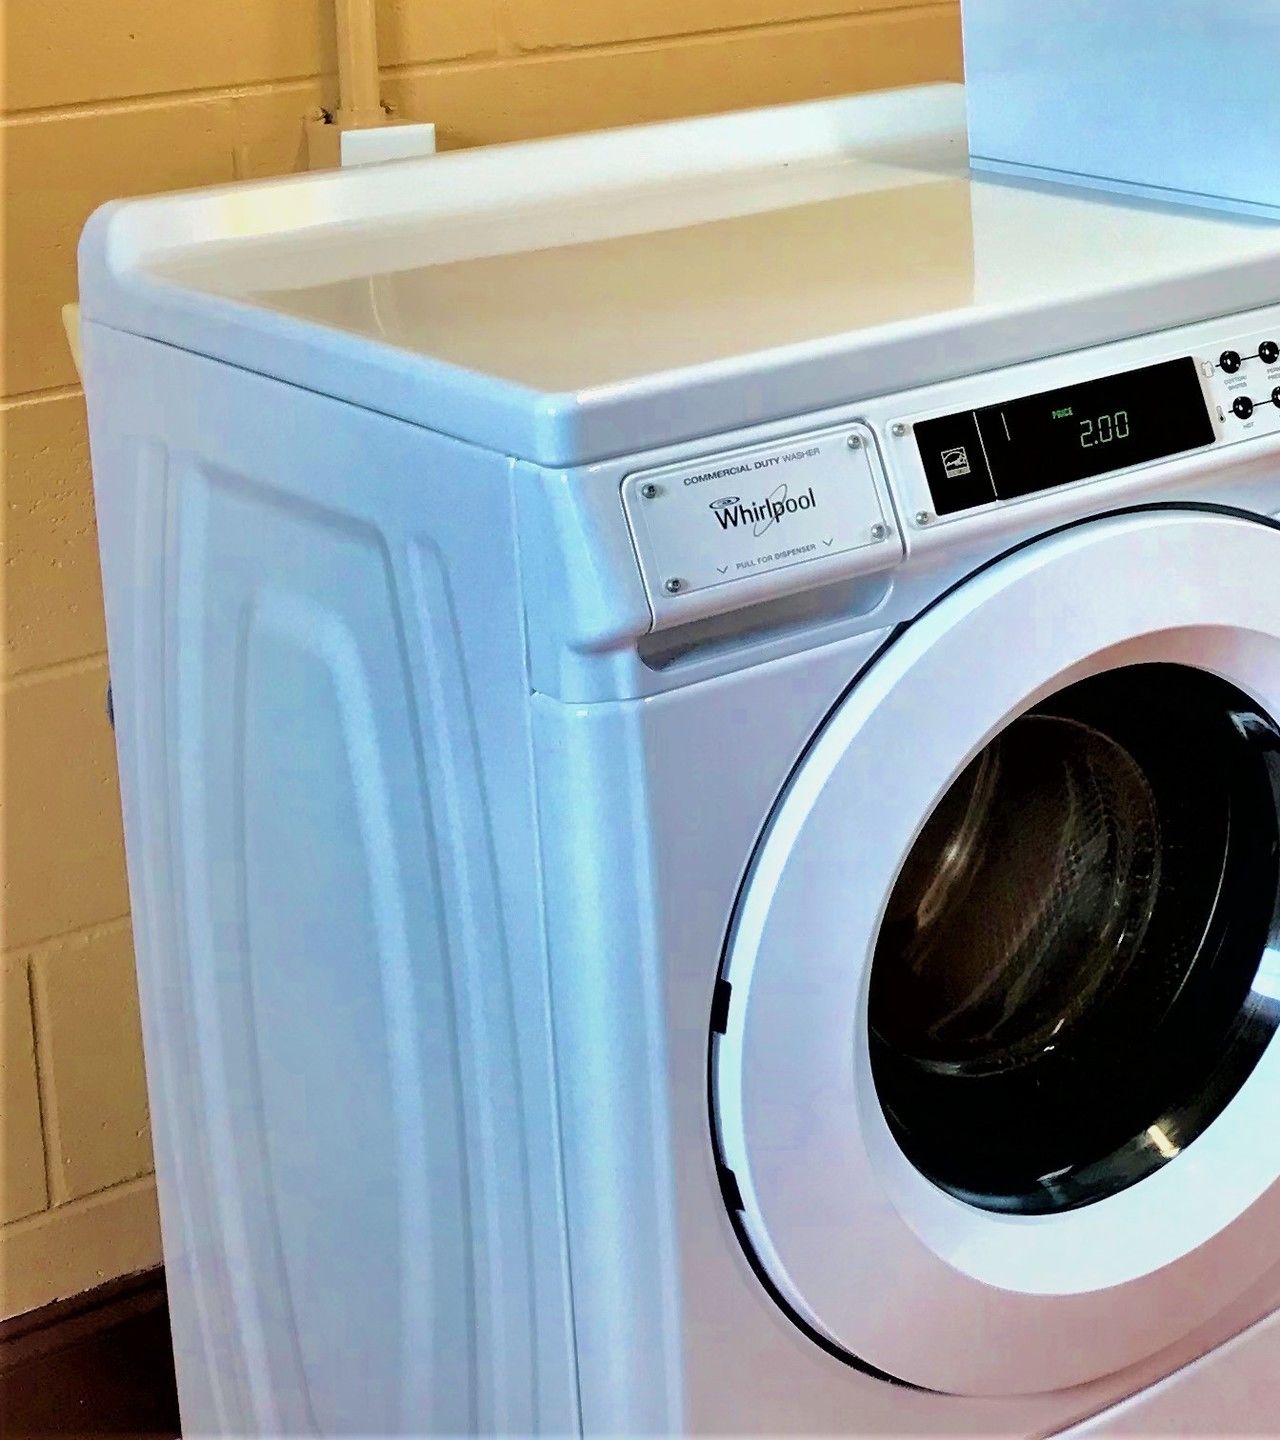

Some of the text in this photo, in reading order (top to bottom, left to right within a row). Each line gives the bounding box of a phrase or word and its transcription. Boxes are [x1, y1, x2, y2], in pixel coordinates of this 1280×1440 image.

[1080, 411, 1129, 448] 2.00
[684, 448, 820, 485] COMMERCIAL DUTY WASHER
[715, 487, 816, 529] Whirlpool
[736, 543, 816, 570] PULL FOR DISPENSER
